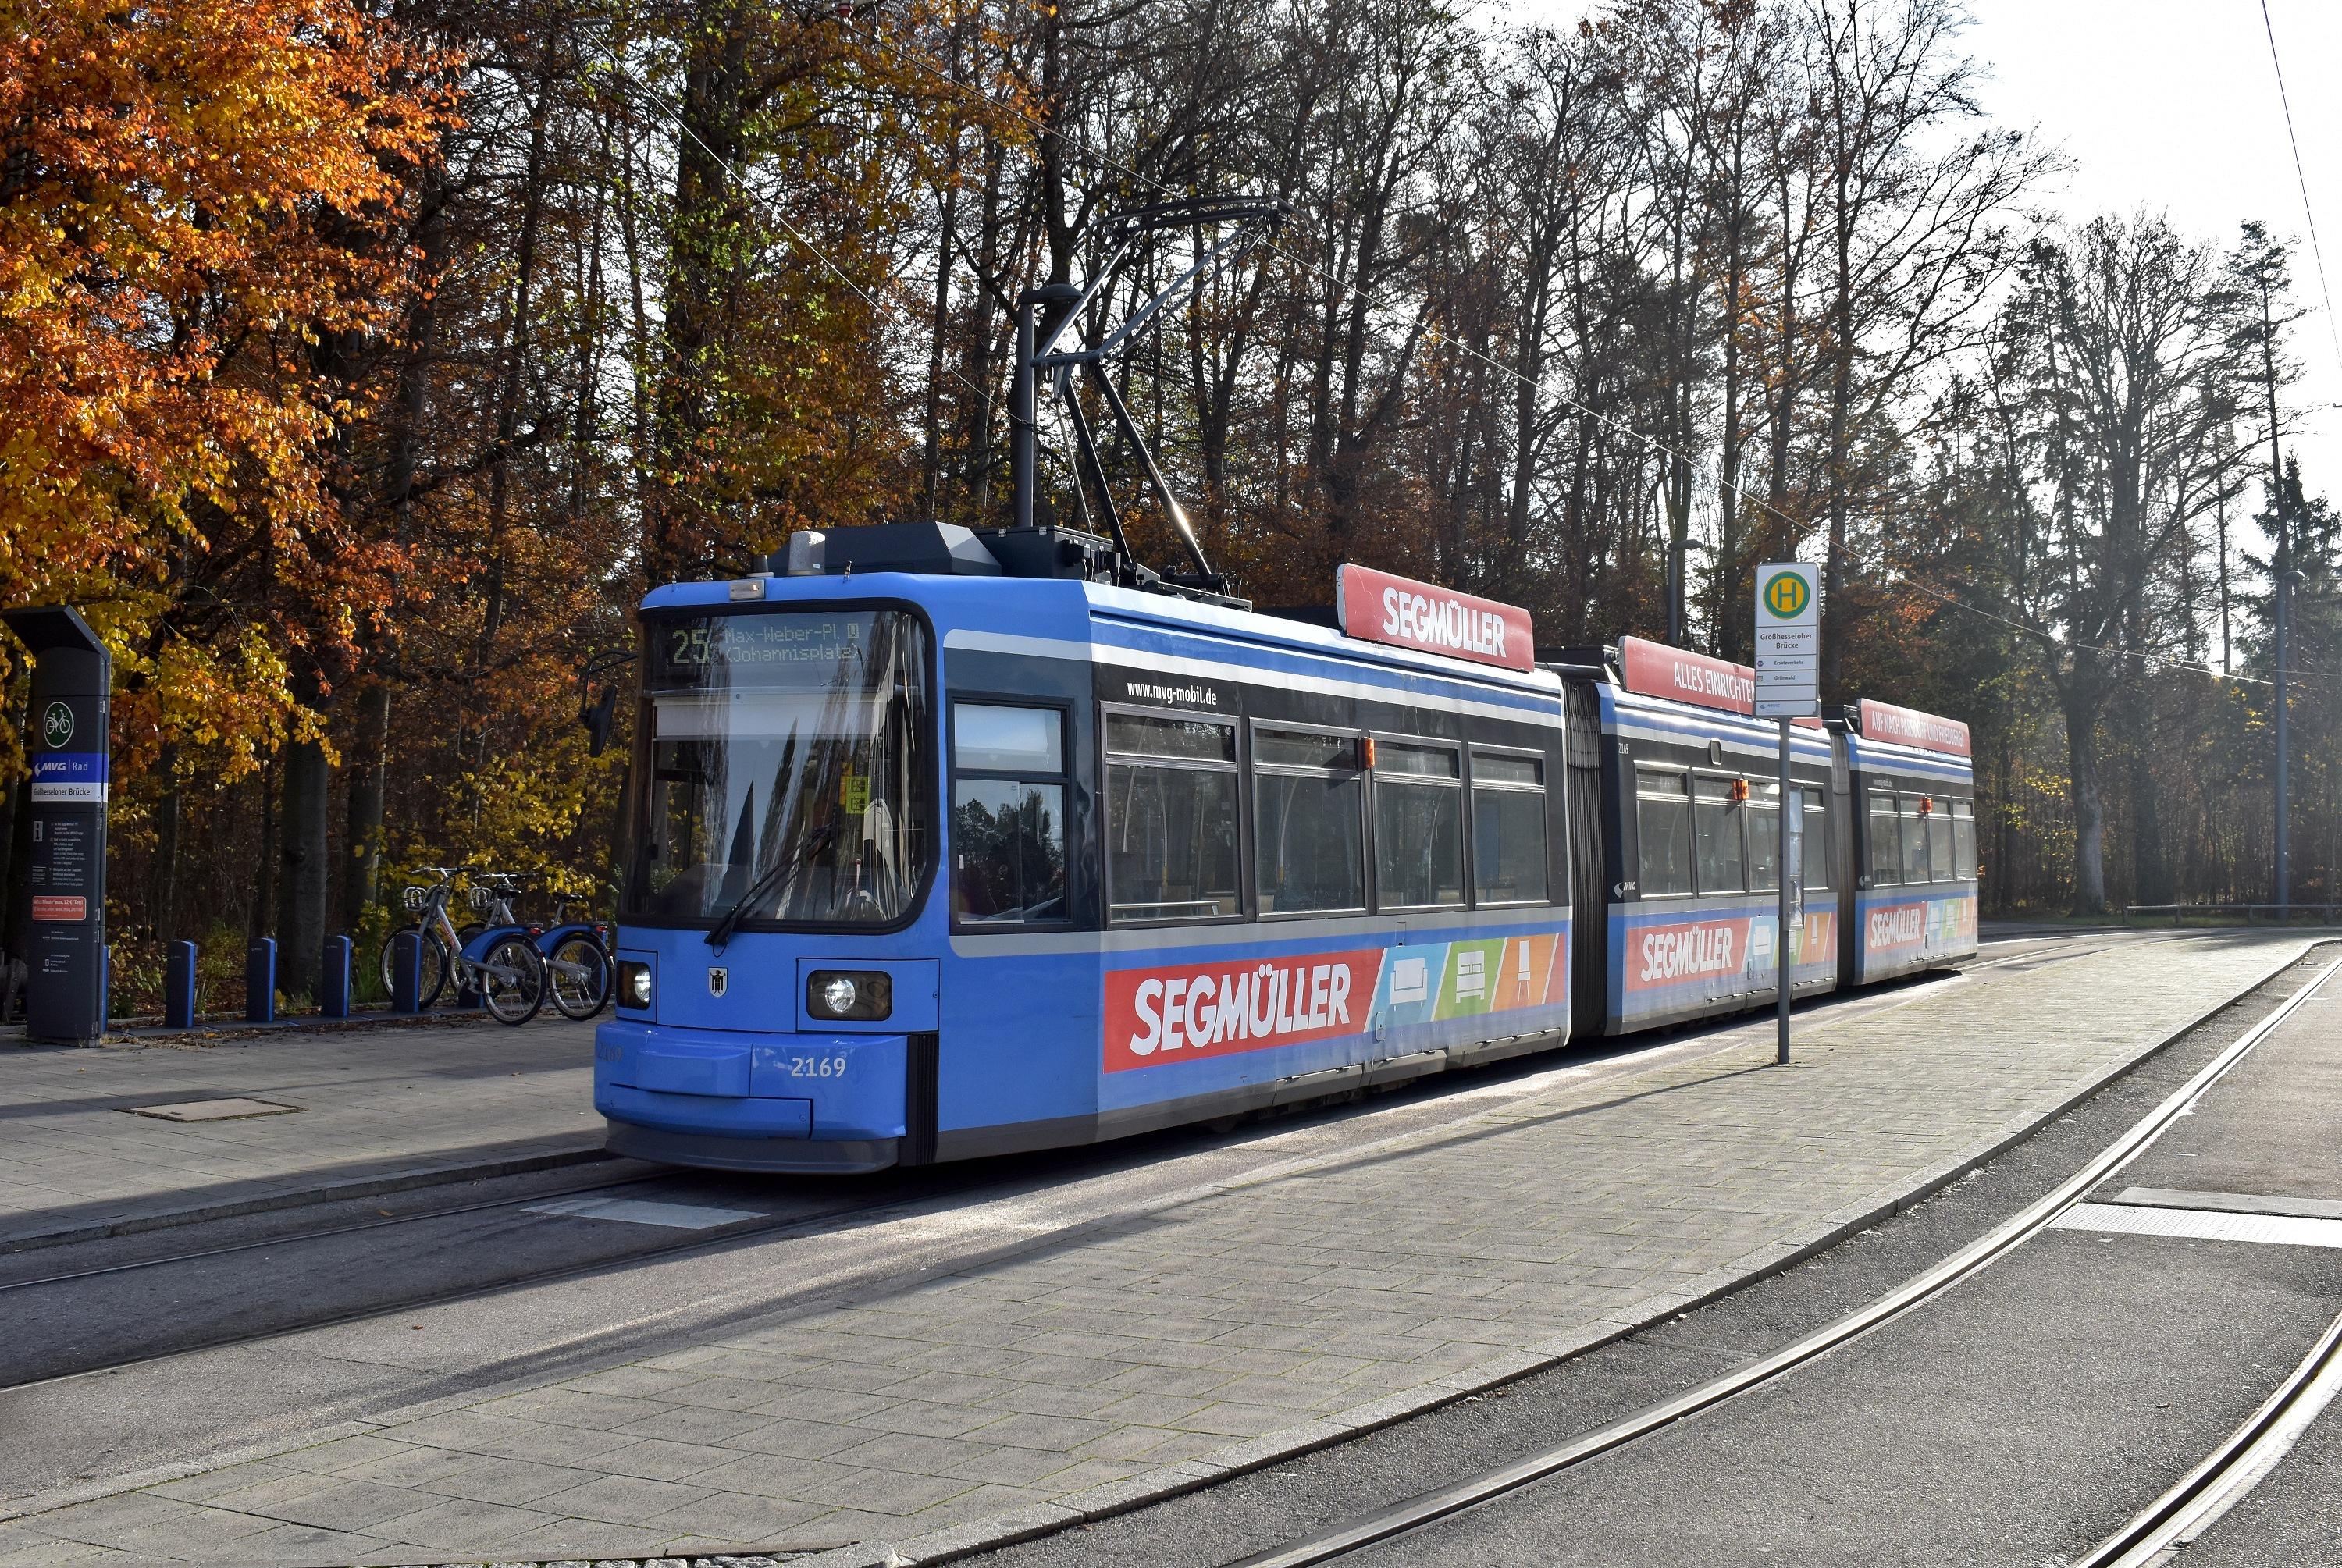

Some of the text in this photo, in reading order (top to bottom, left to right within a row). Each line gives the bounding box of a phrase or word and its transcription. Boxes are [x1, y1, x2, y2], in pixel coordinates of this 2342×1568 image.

[1383, 587, 1506, 658] SEGMÜLLER
[672, 629, 709, 663] 25
[724, 624, 840, 644] Max-Weber-Pl.
[1674, 662, 1703, 692] ALLES
[1127, 682, 1217, 705] www.mvg-mobil.de
[1872, 711, 1884, 731] AUF
[1884, 713, 1902, 734] NACH
[41, 761, 88, 771] MVG Rad
[1624, 881, 1636, 891] MVG
[1870, 907, 1920, 948] SEGMÜLLER
[1641, 926, 1732, 982] SEGMÜLLER
[1130, 963, 1351, 1056] SEGMÜLLER
[791, 1057, 846, 1078] 2169
